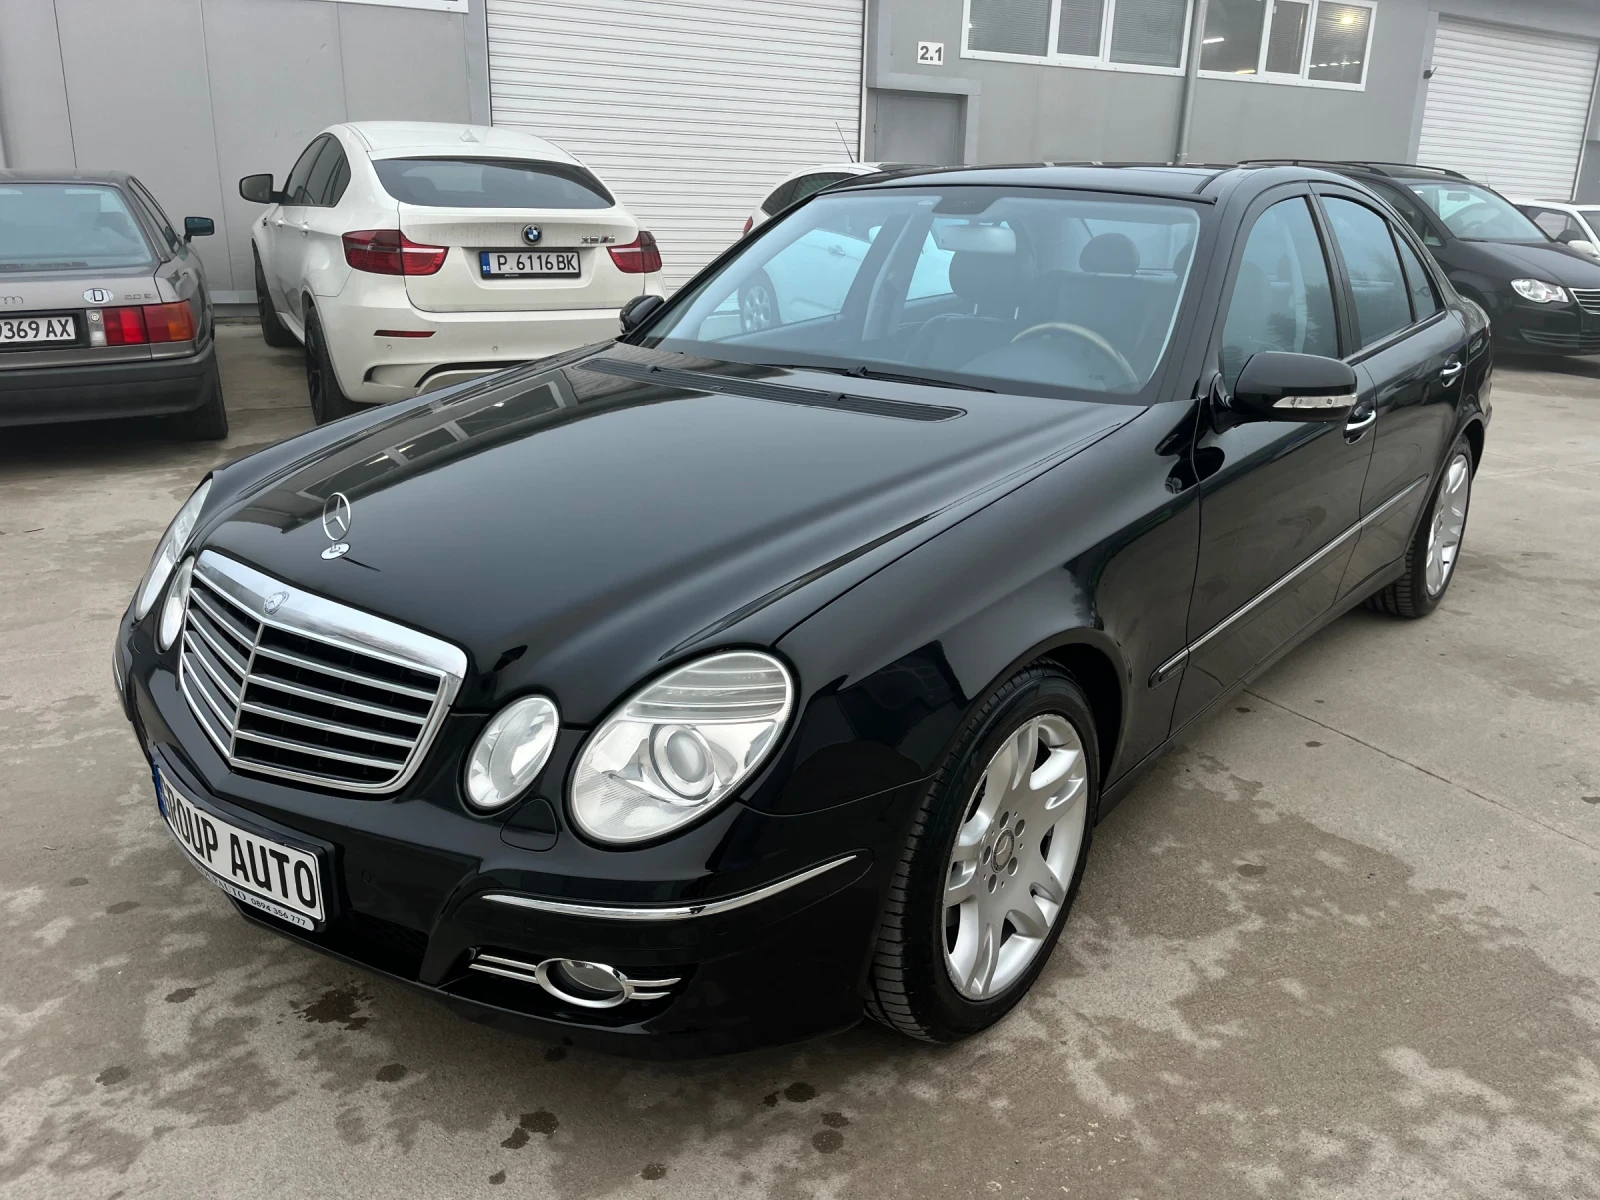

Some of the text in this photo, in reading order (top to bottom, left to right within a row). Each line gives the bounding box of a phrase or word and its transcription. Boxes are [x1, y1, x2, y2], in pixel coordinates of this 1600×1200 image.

[919, 45, 942, 61] 2.1
[93, 289, 104, 301] D
[0, 319, 71, 340] 369 AX
[230, 832, 317, 909] AUTO
[290, 914, 306, 926] 777
